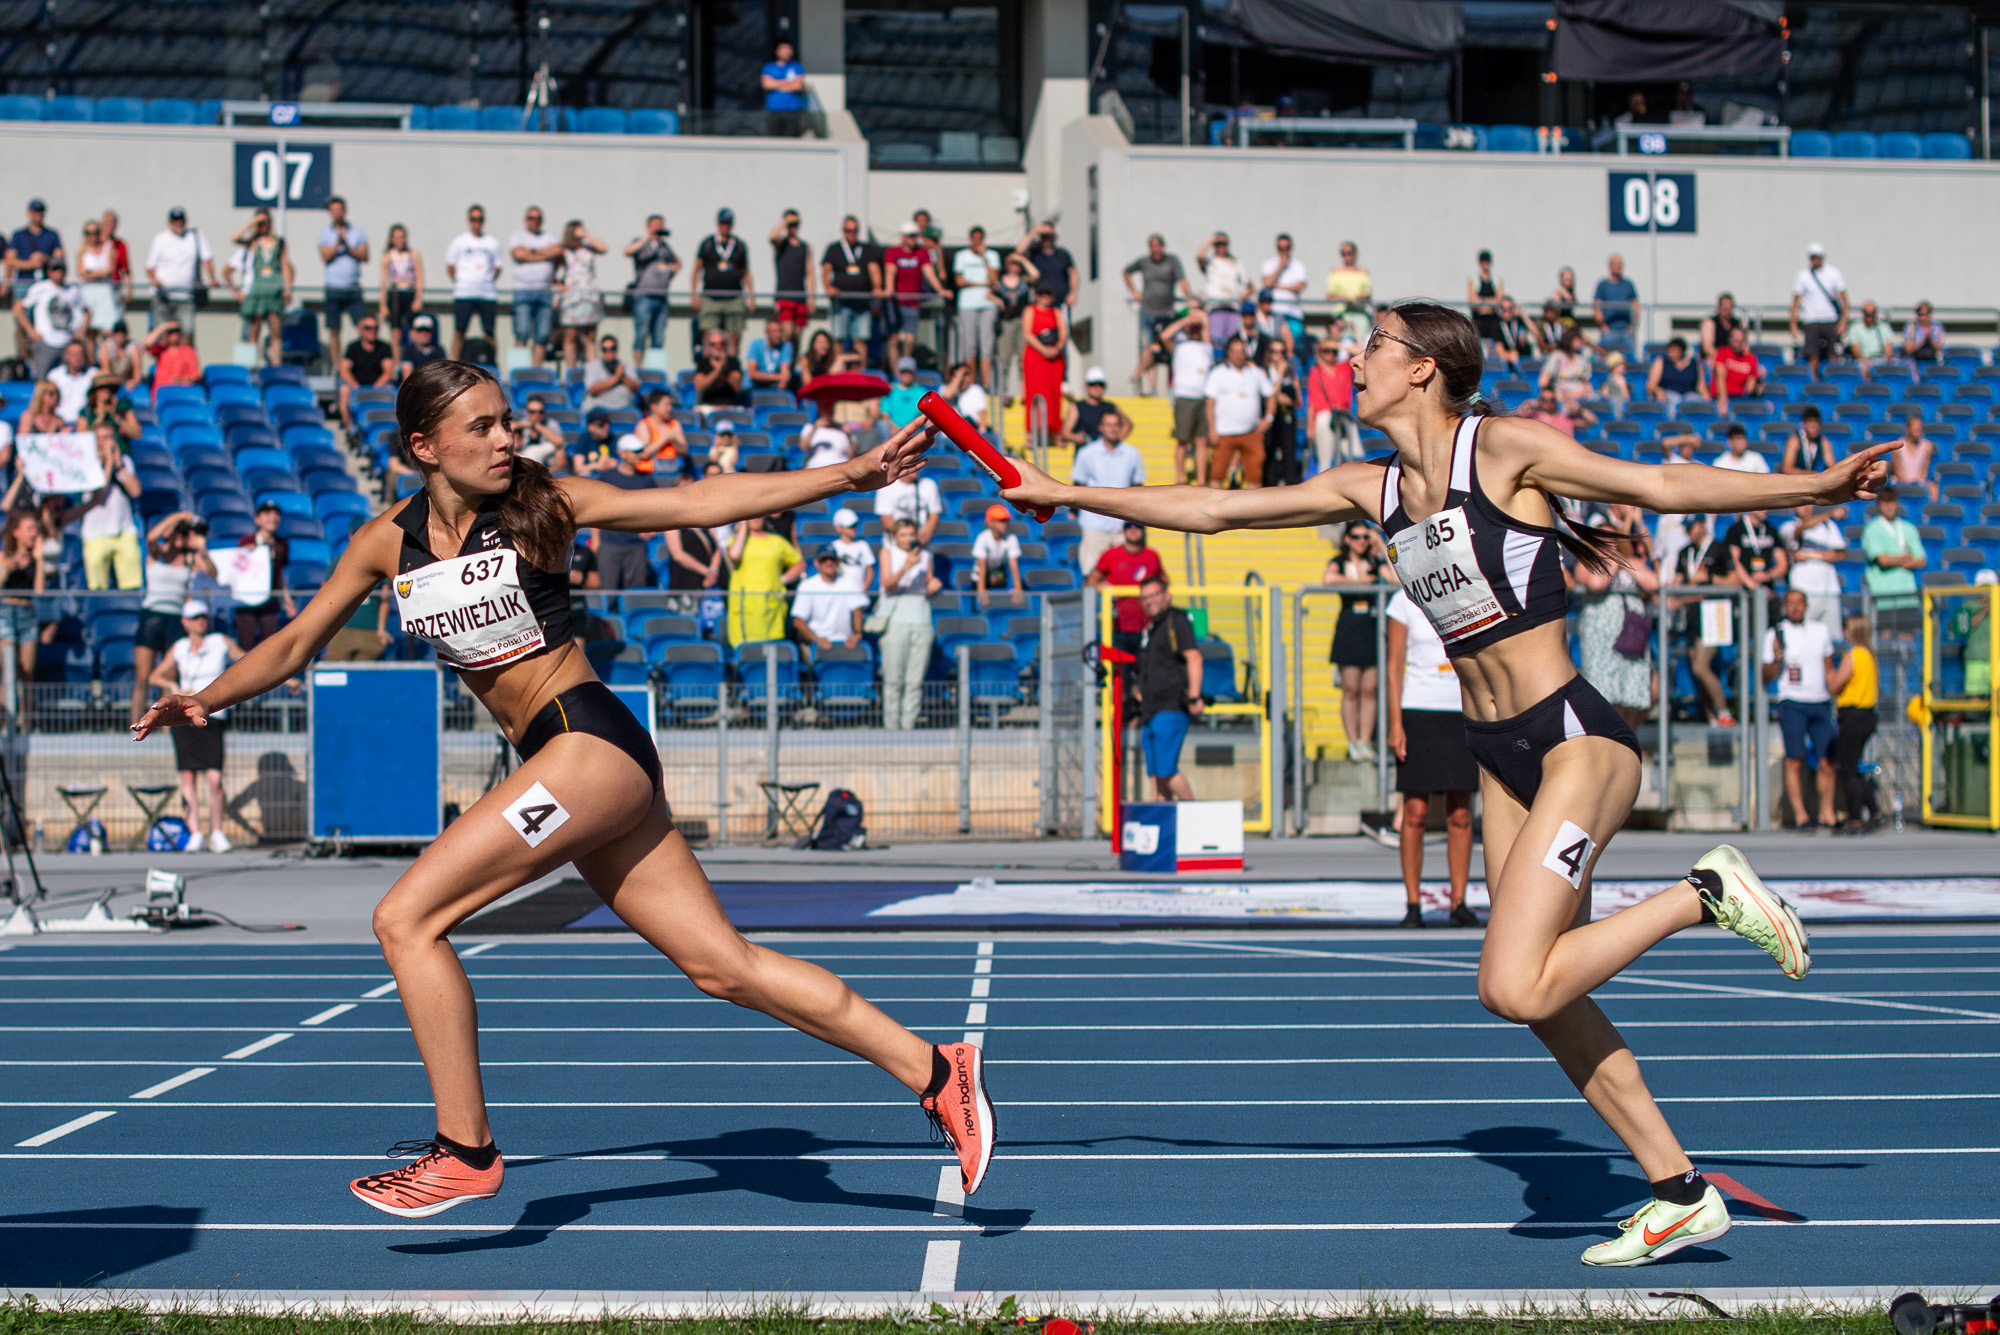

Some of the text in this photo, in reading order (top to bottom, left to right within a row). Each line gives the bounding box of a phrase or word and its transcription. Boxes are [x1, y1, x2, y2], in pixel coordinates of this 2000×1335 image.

[271, 104, 298, 125] 07
[1639, 133, 1667, 154] 08
[251, 150, 314, 201] 07
[1623, 177, 1681, 228] 08
[482, 537, 501, 548] AIR
[1425, 517, 1455, 550] 635
[461, 554, 504, 586] 637
[1404, 563, 1473, 606] MUCHA
[406, 591, 527, 640] PRZEWIEŹLIK
[1481, 601, 1498, 614] U18
[497, 638, 522, 651] Polski
[523, 629, 540, 641] U18
[518, 803, 558, 836] 4
[1557, 837, 1589, 878] 4
[956, 1047, 976, 1137] new balance
